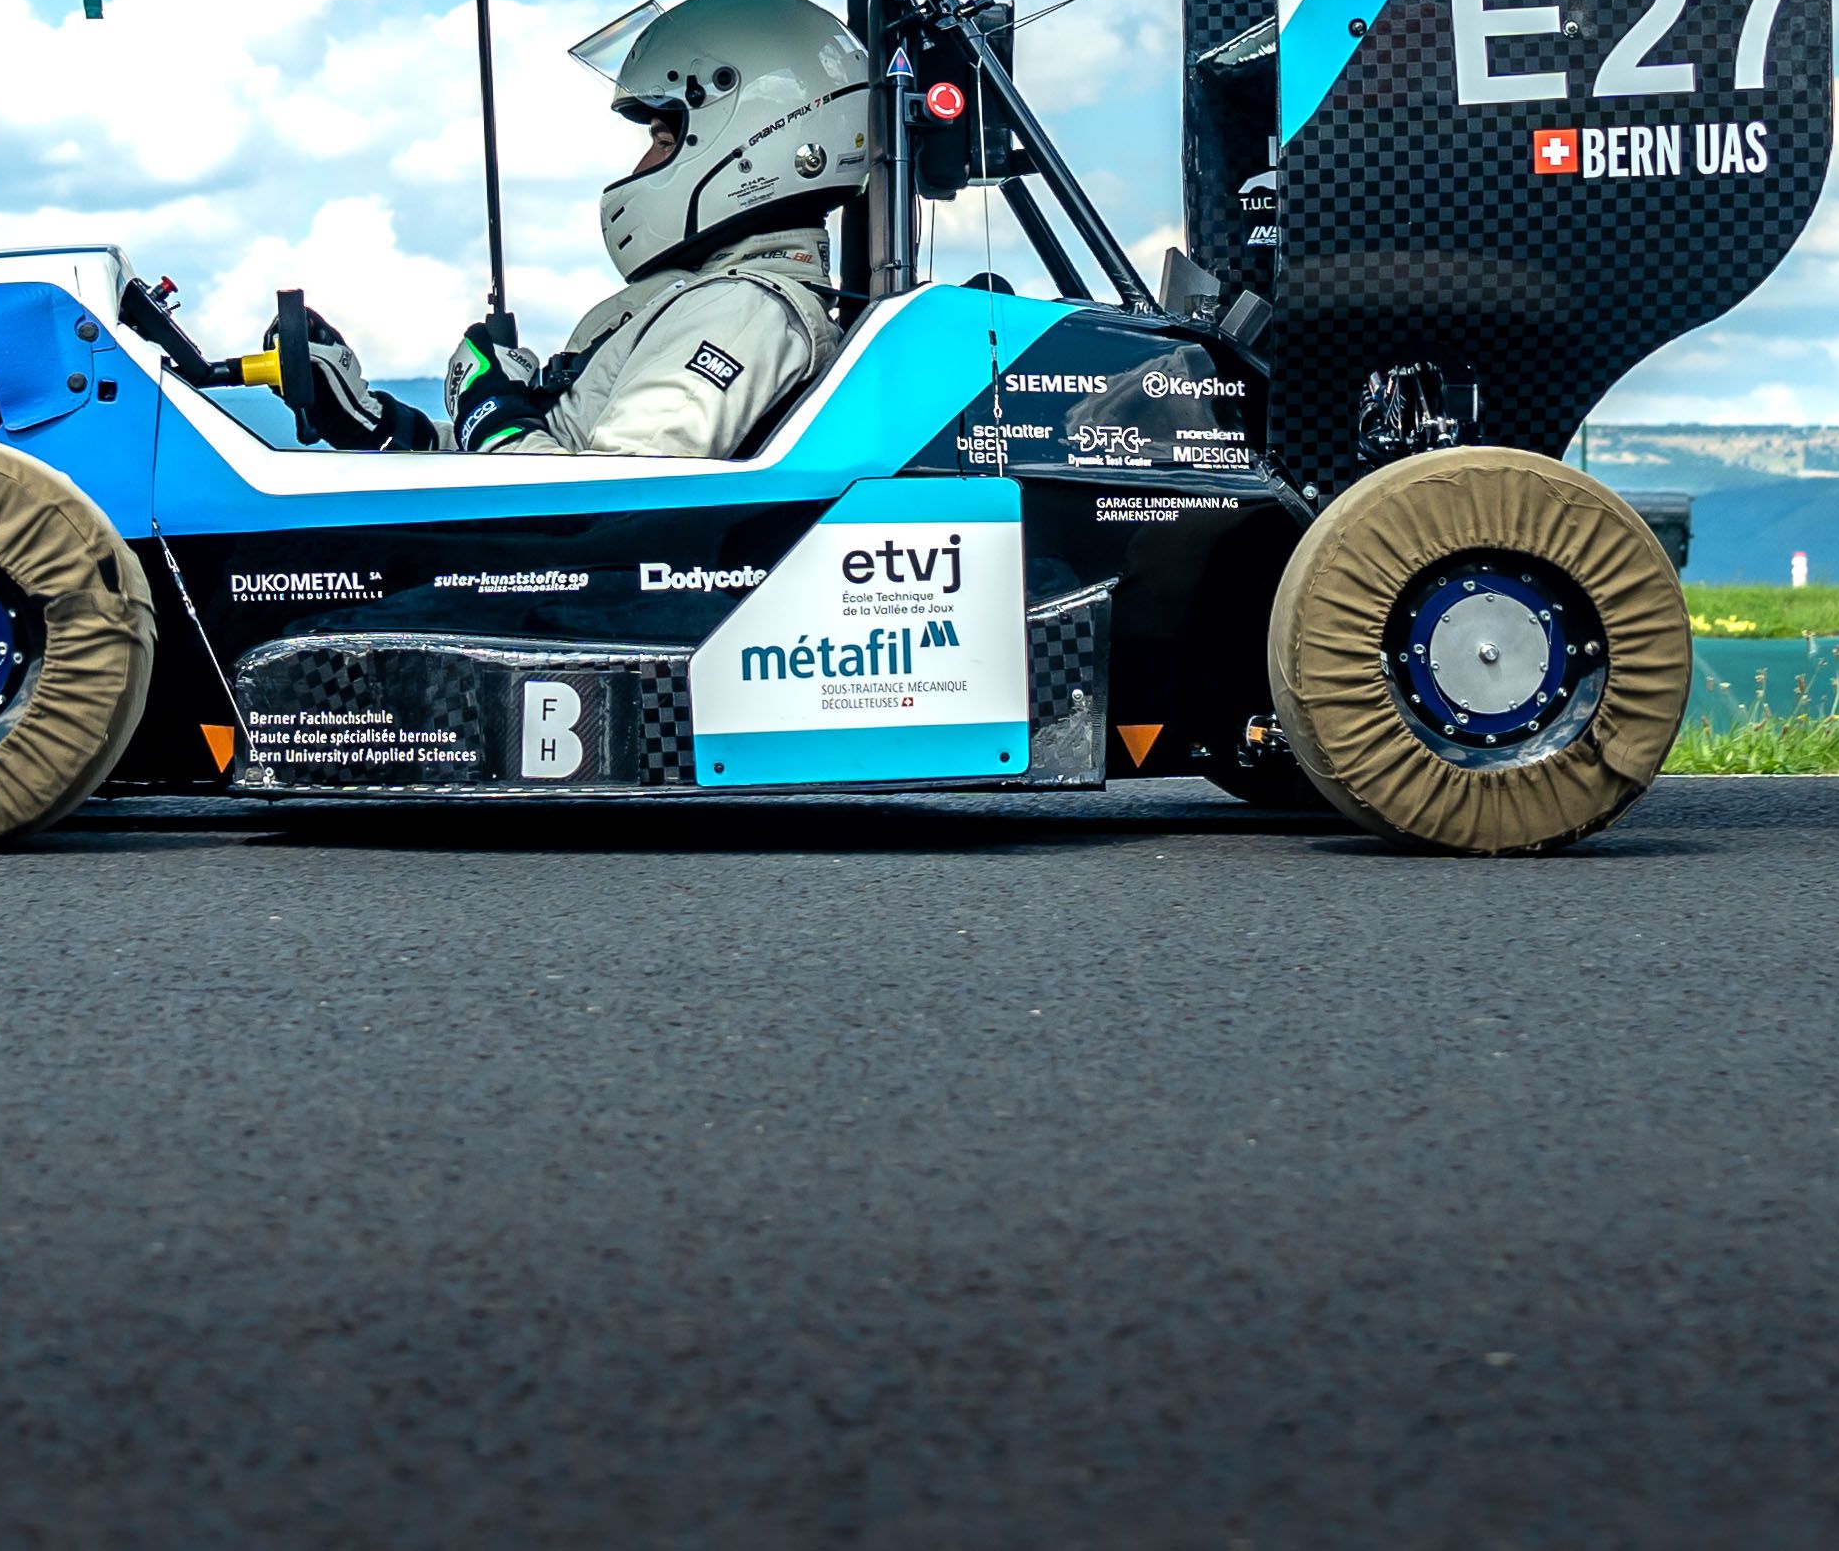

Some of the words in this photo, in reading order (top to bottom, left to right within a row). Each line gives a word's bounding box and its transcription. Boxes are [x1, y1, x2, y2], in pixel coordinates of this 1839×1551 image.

[787, 103, 812, 123] PRIX
[1582, 125, 1681, 179] BERN
[1696, 121, 1768, 176] UAS
[697, 352, 733, 378] OMP
[1005, 374, 1108, 394] SIEMENS
[1170, 377, 1245, 399] KeyShot
[973, 424, 1053, 439] schlatter
[1176, 429, 1245, 441] norelem
[956, 436, 1007, 451] blech
[969, 450, 1008, 464] tech
[1173, 446, 1249, 463] MDESIGN
[1096, 498, 1142, 508] GARAGE
[1145, 497, 1220, 509] LINDENMANN
[1222, 498, 1239, 508] AG
[1096, 510, 1179, 521] SARMENSTORF
[842, 534, 961, 594] etvj
[231, 573, 364, 592] DUKOMETAL
[369, 572, 383, 580] SA
[639, 562, 767, 592] Bodycote
[291, 591, 383, 600] INDUSTRIELLE
[842, 590, 873, 603] École
[876, 592, 934, 603] Technique
[843, 606, 857, 616] de
[860, 606, 870, 615] la
[874, 605, 908, 615] Vallée
[911, 605, 925, 613] de
[928, 604, 954, 614] Joux
[741, 628, 912, 681] métafil
[821, 682, 904, 695] SOUS-TRAITANCE
[907, 680, 968, 692] MÉCANIQUE
[821, 696, 899, 709] DÉCOLLETEUSES
[249, 711, 297, 725] Berner
[299, 710, 394, 725] Fachhochschule
[250, 731, 290, 744] Haute
[293, 730, 328, 743] école
[330, 729, 396, 746] spécialisée
[399, 729, 457, 743] bernoise
[249, 750, 282, 763] Bern
[285, 749, 349, 765] University
[351, 749, 363, 762] of
[366, 749, 413, 764] Applied
[418, 748, 477, 762] Sciences
